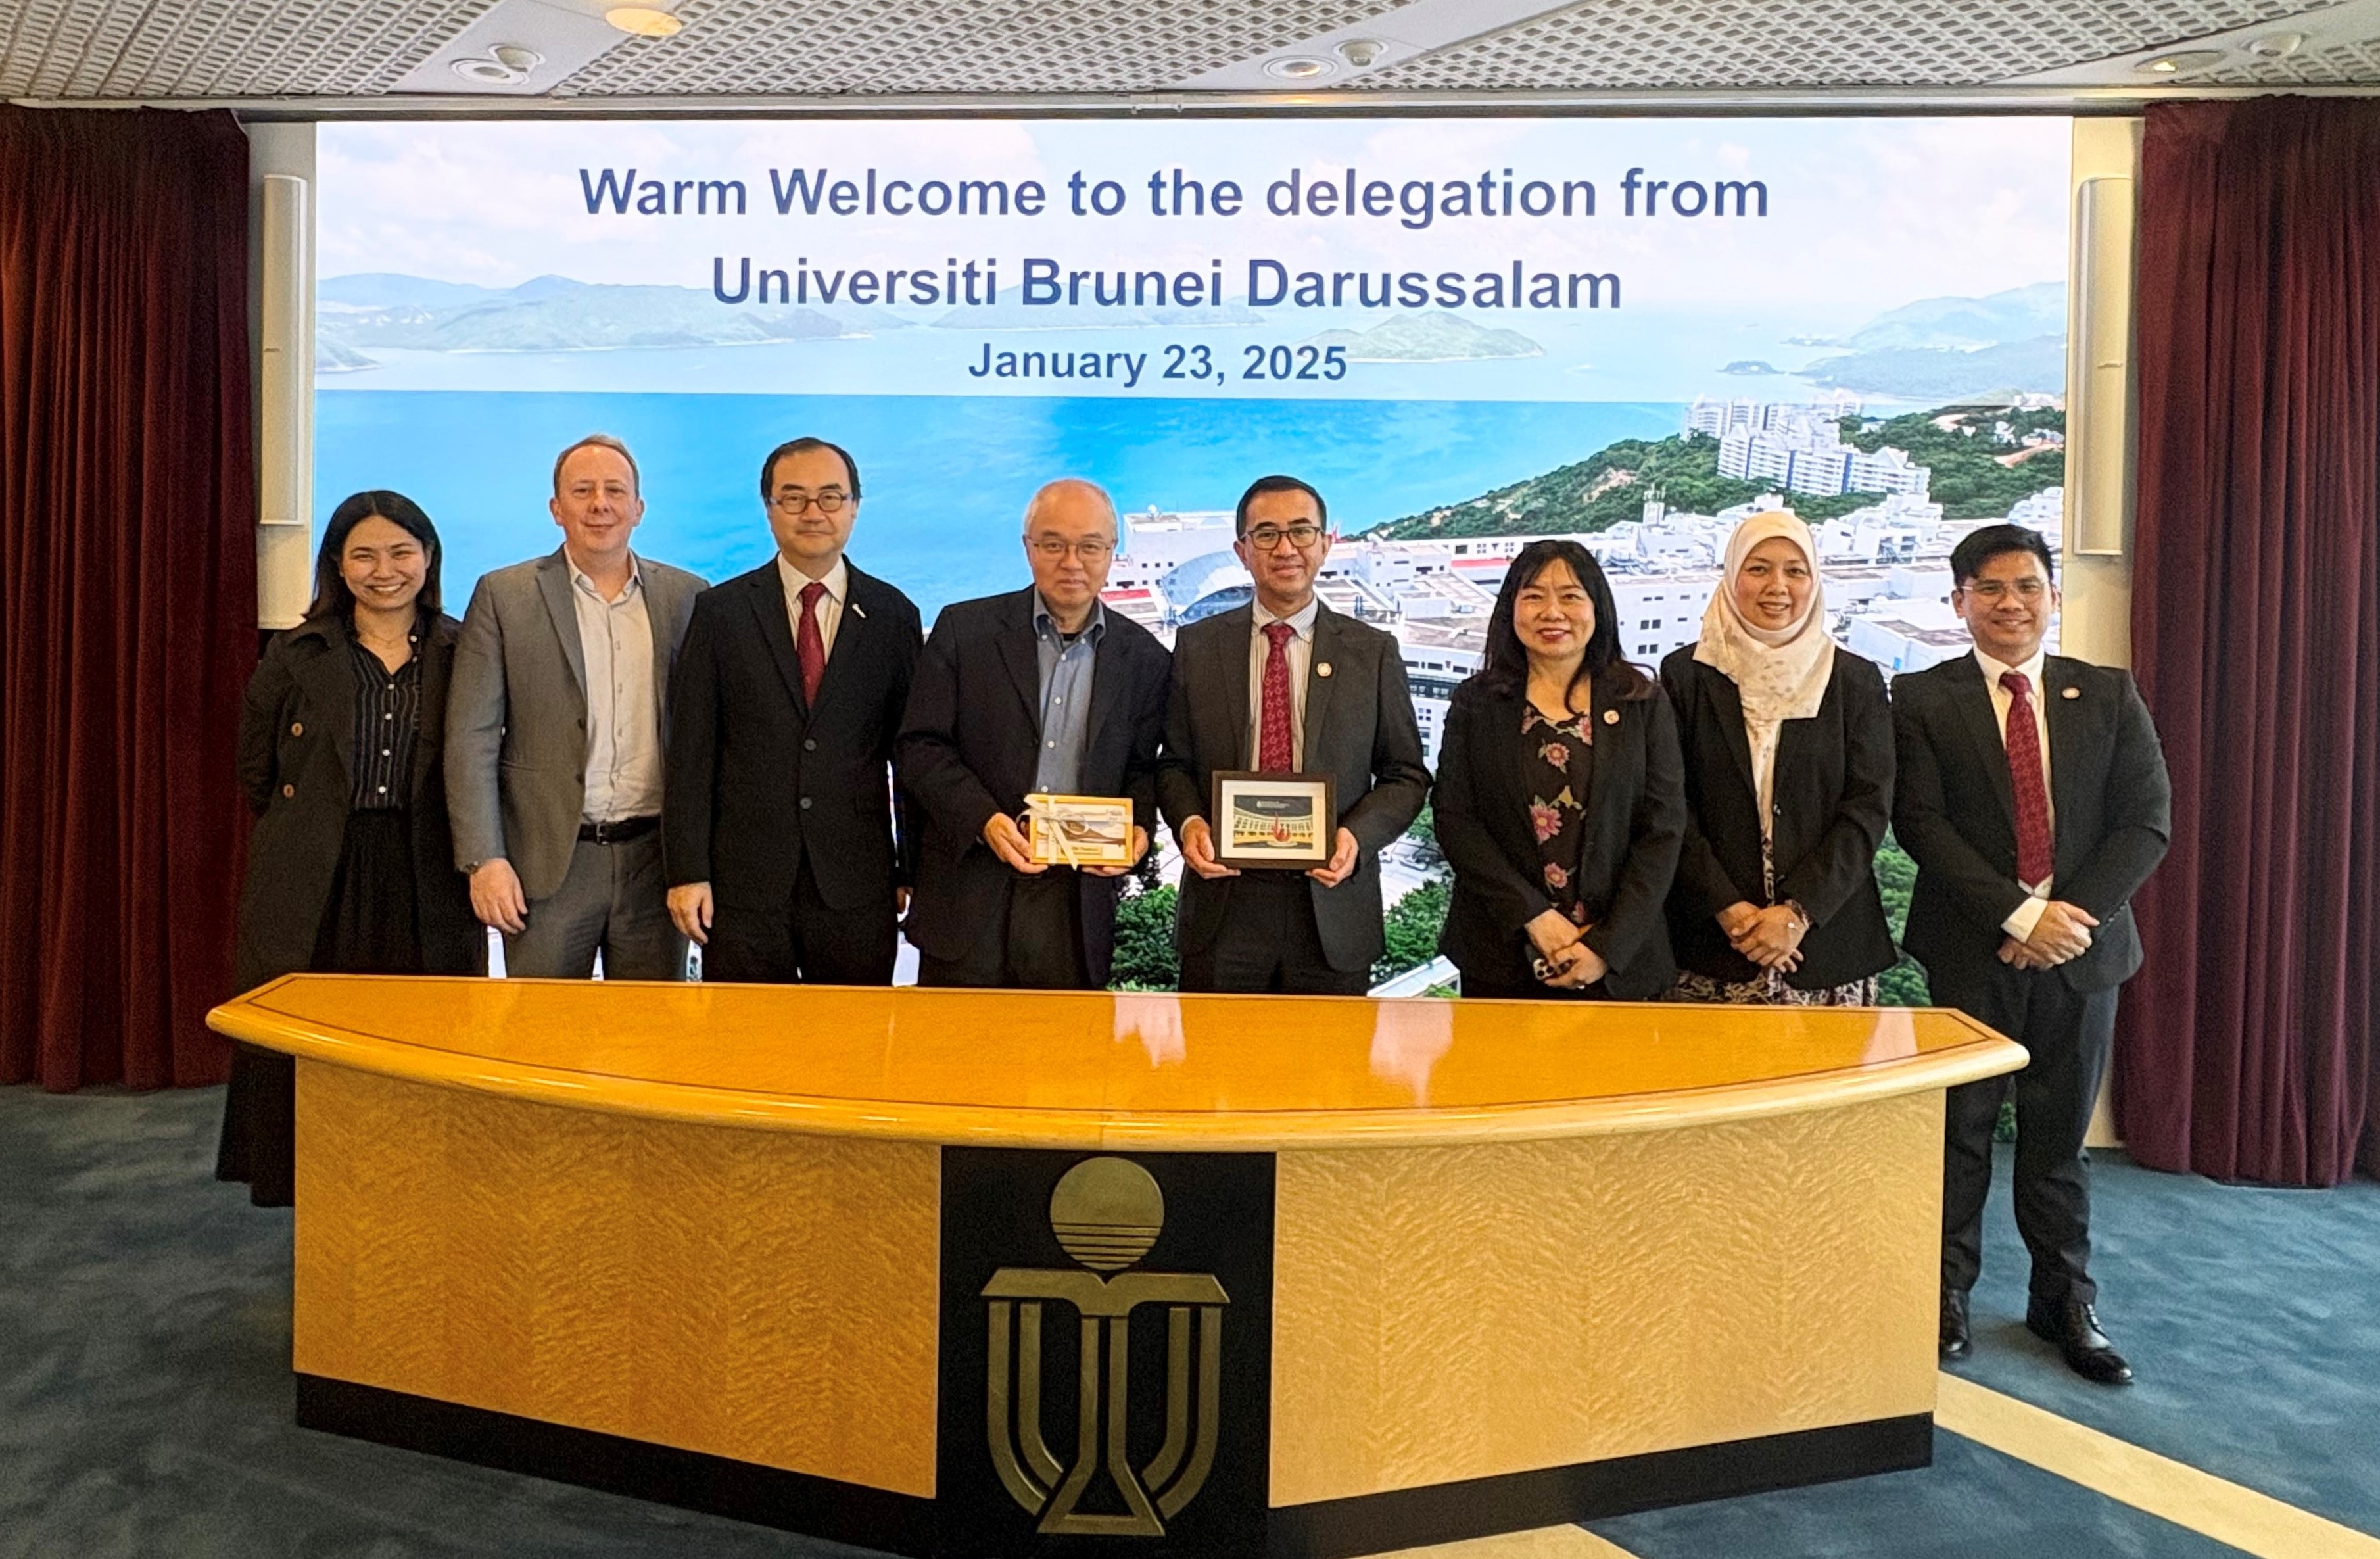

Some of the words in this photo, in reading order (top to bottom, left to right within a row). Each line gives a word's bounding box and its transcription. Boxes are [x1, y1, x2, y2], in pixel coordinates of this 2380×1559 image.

[579, 168, 746, 215] Warm
[769, 168, 1045, 216] Welcome
[1067, 170, 1126, 216] to
[1147, 168, 1243, 216] the
[1267, 168, 1596, 229] delegation
[1620, 168, 1767, 217] from
[714, 257, 996, 306] Universiti
[1022, 258, 1221, 307] Brunei
[1248, 259, 1620, 309] Darussalam
[968, 343, 1147, 389] January
[1162, 344, 1225, 387] 23,
[1242, 345, 1347, 381] 2025
